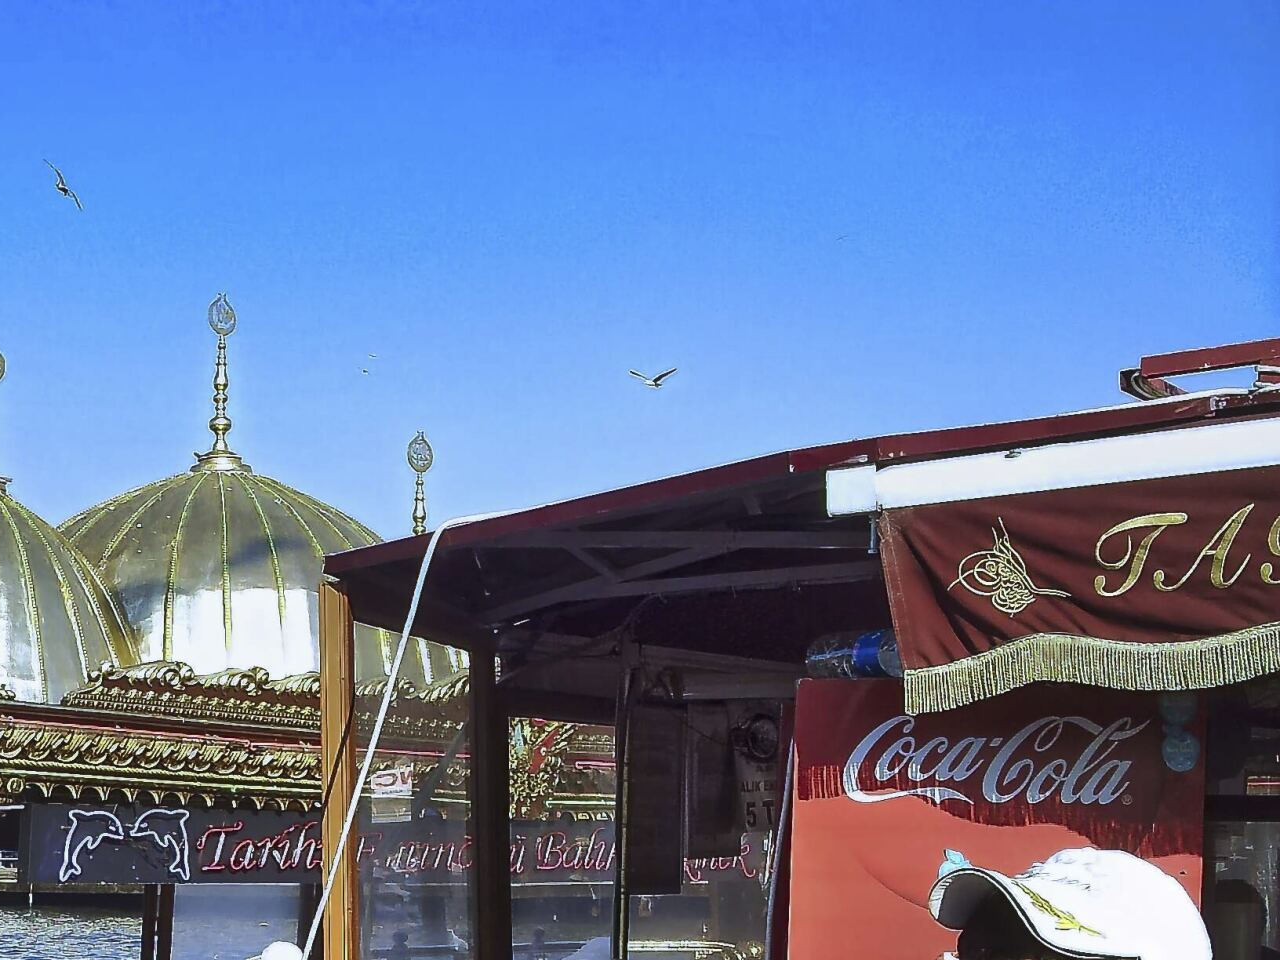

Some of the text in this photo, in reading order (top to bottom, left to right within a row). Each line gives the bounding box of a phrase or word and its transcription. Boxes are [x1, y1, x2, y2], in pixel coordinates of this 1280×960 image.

[1094, 502, 1280, 598] TA
[842, 714, 1151, 805] Coca-Cola
[196, 820, 322, 870] Tarih
